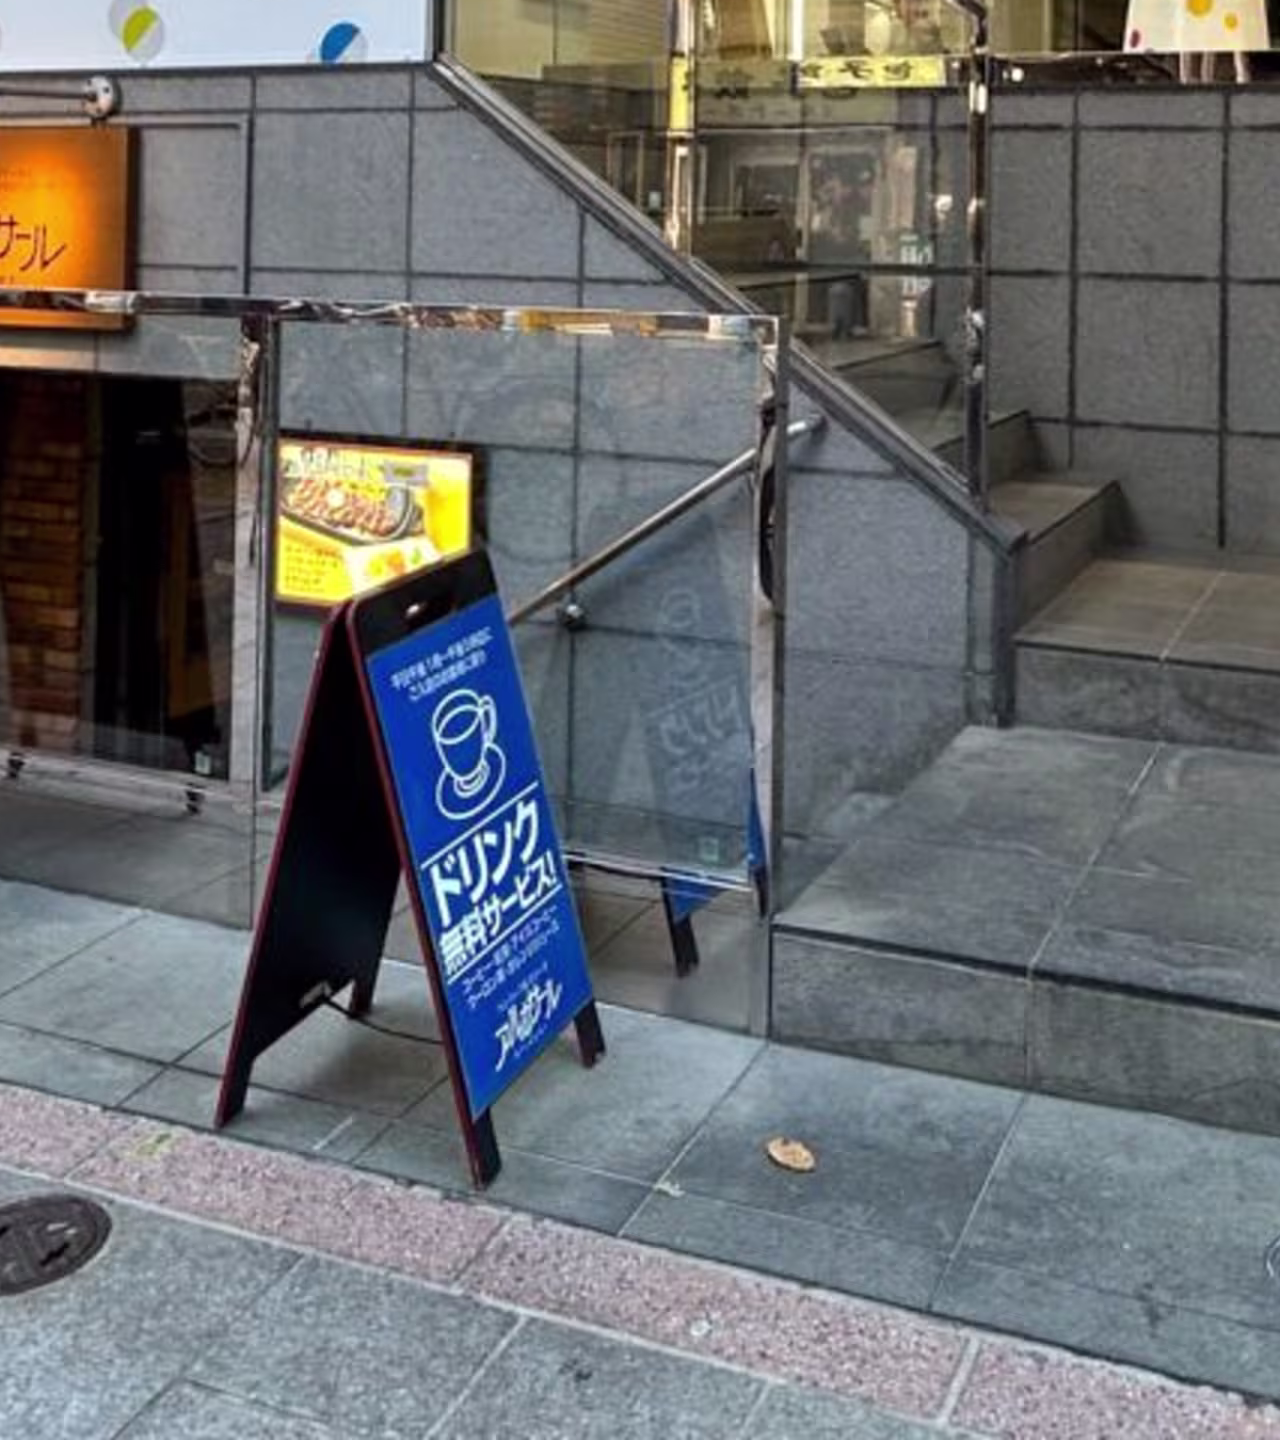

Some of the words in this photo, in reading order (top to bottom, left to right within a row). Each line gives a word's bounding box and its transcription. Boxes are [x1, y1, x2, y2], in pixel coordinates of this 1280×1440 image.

[429, 798, 540, 930] ドリンク
[438, 848, 558, 976] 無料サービス!
